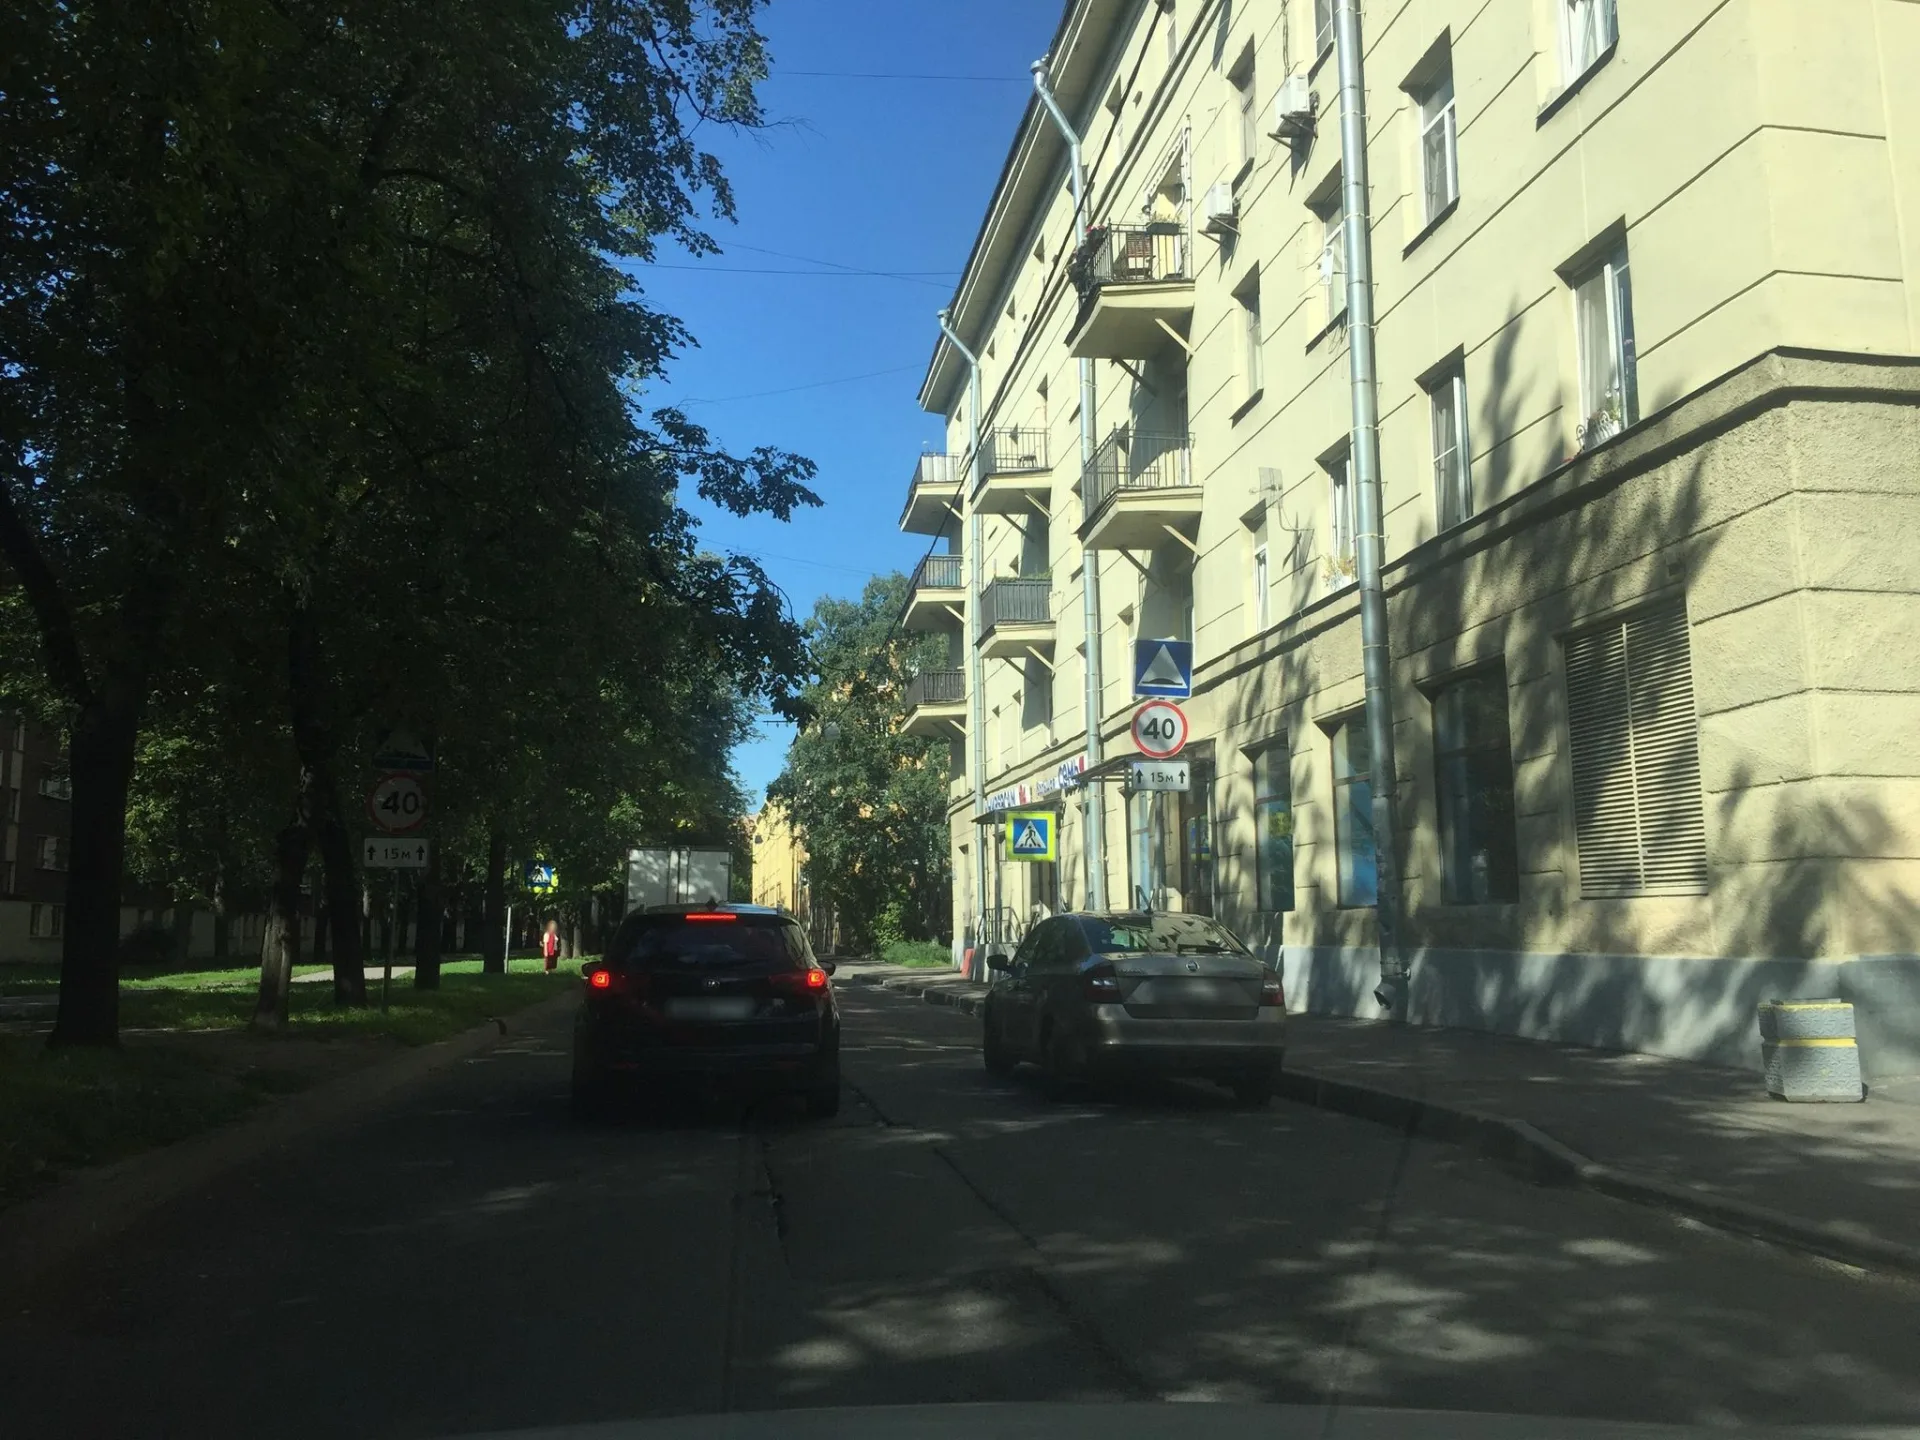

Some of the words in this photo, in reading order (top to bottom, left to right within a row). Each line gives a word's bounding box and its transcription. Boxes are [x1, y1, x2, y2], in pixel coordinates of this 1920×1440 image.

[1142, 717, 1175, 740] 40
[1150, 772, 1174, 783] 15м
[381, 790, 420, 815] 40
